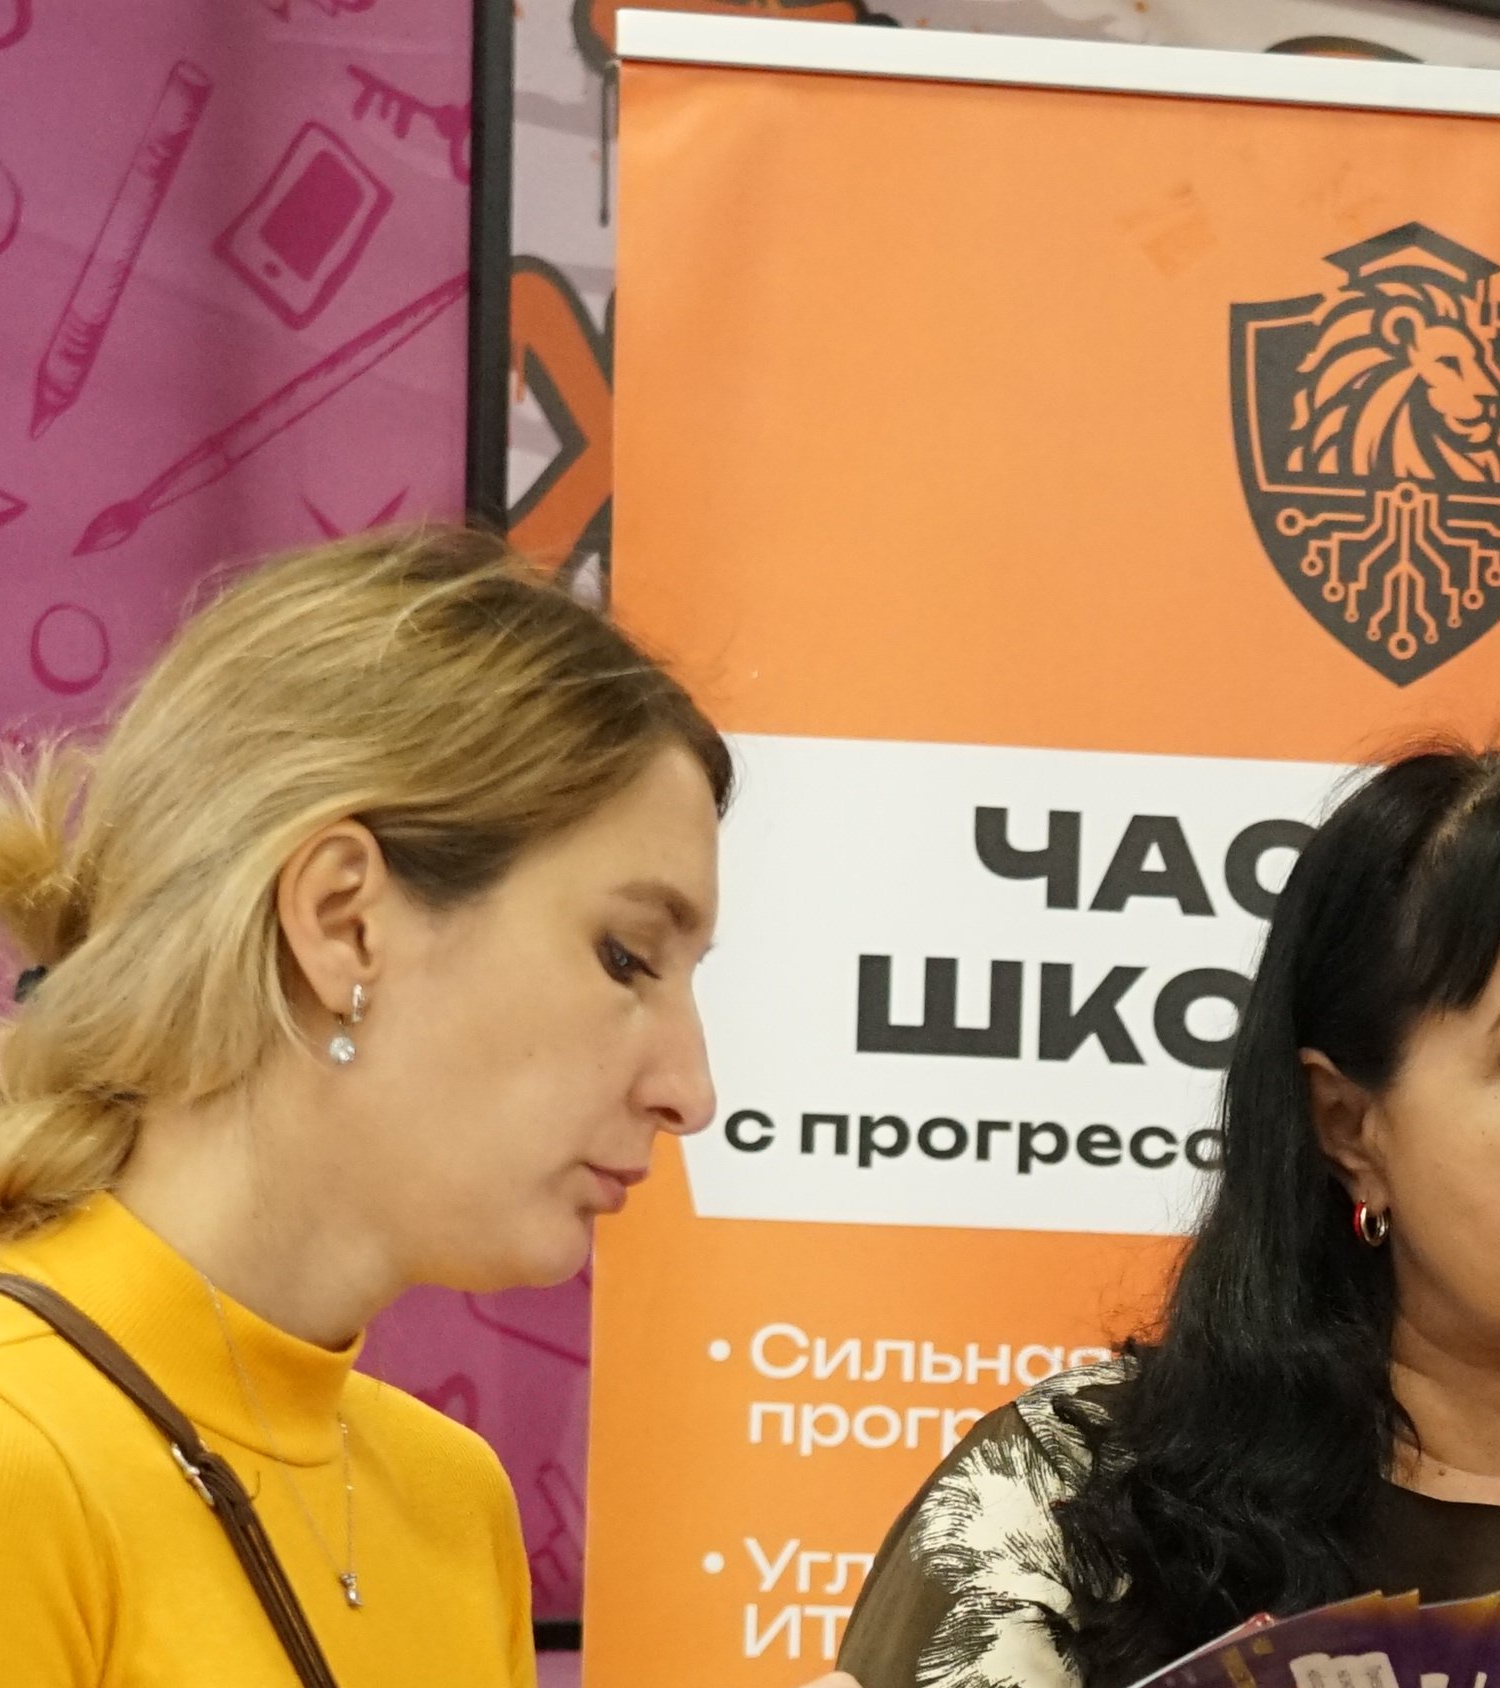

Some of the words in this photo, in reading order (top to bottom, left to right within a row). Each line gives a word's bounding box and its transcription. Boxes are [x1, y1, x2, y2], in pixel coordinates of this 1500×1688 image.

[856, 954, 1257, 1071] ШКО
[725, 1110, 776, 1153] с
[800, 1113, 1227, 1175] прогресс
[748, 1402, 985, 1457] прогр
